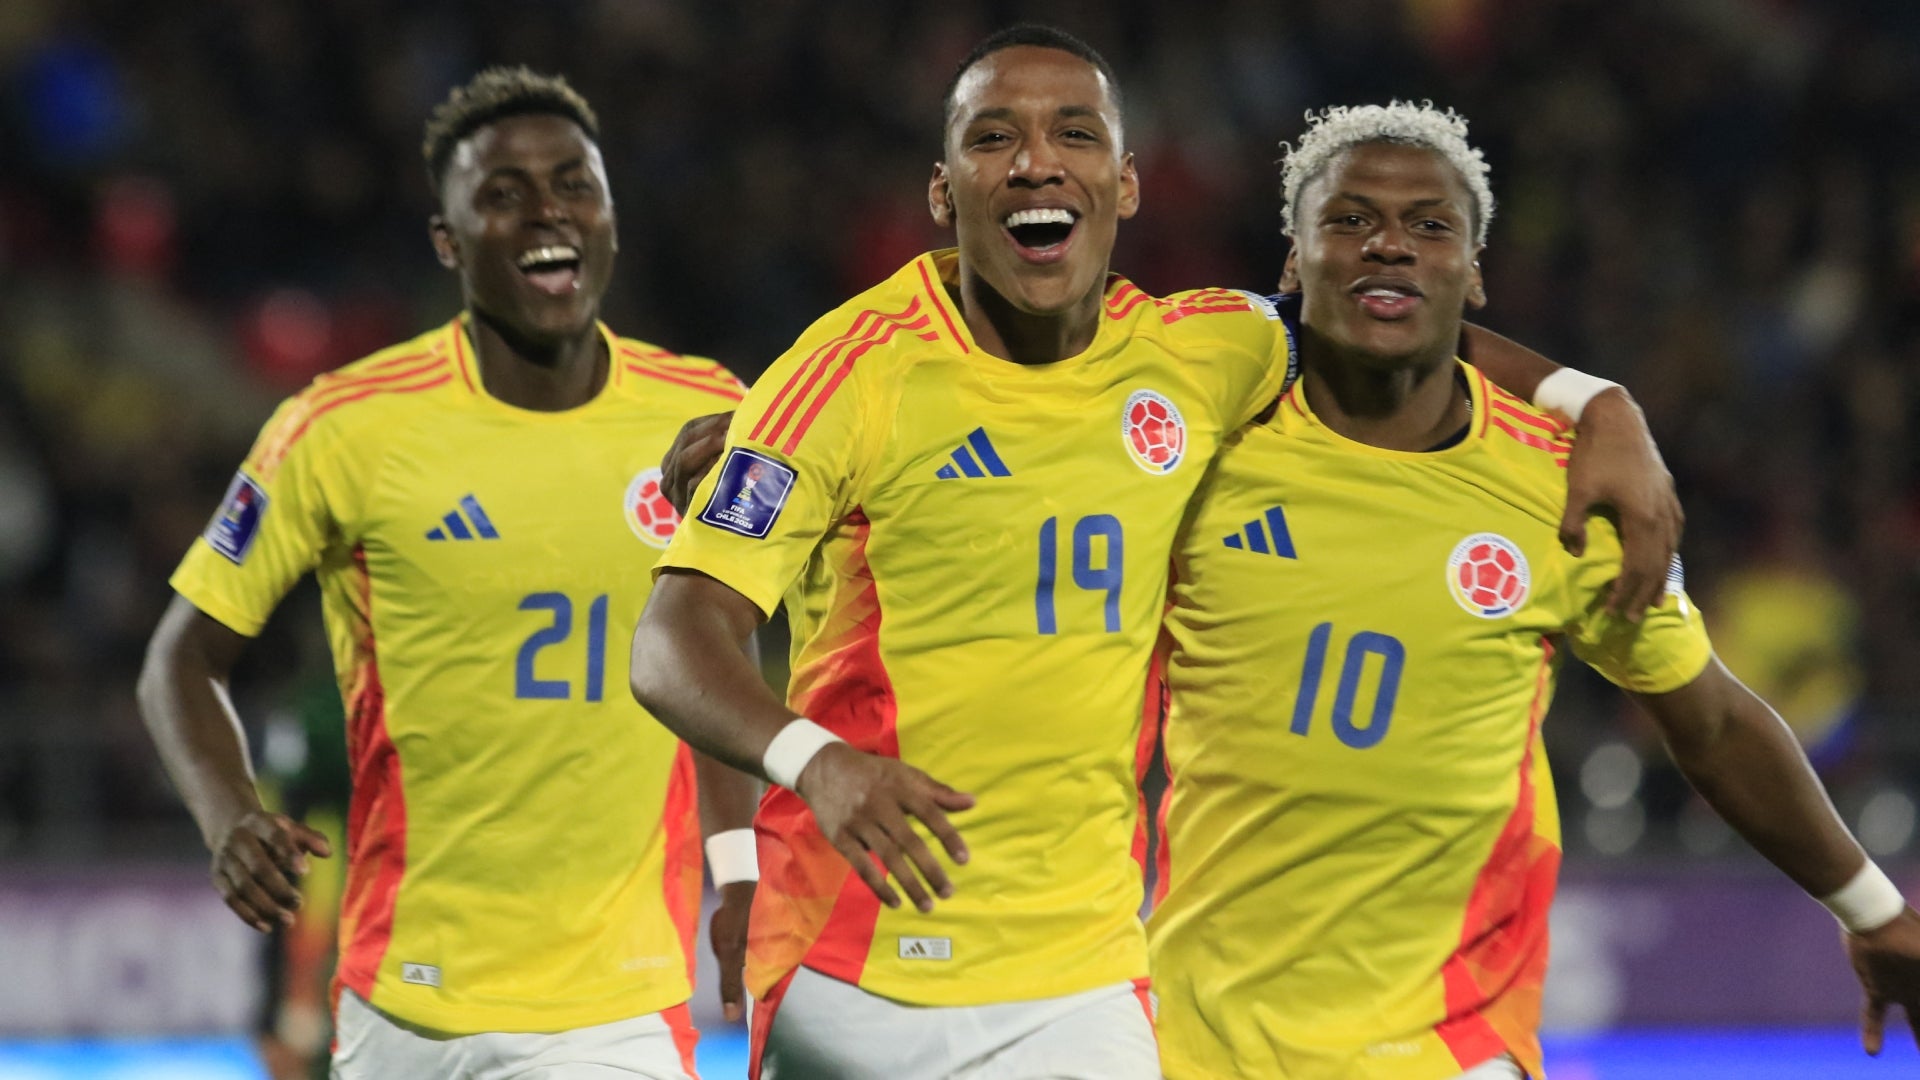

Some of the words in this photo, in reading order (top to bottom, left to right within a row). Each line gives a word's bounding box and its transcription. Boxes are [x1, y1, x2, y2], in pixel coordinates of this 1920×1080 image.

[730, 504, 745, 514] FIFA
[1035, 513, 1124, 635] 19
[515, 591, 609, 702] 21
[1289, 621, 1406, 749] 10
